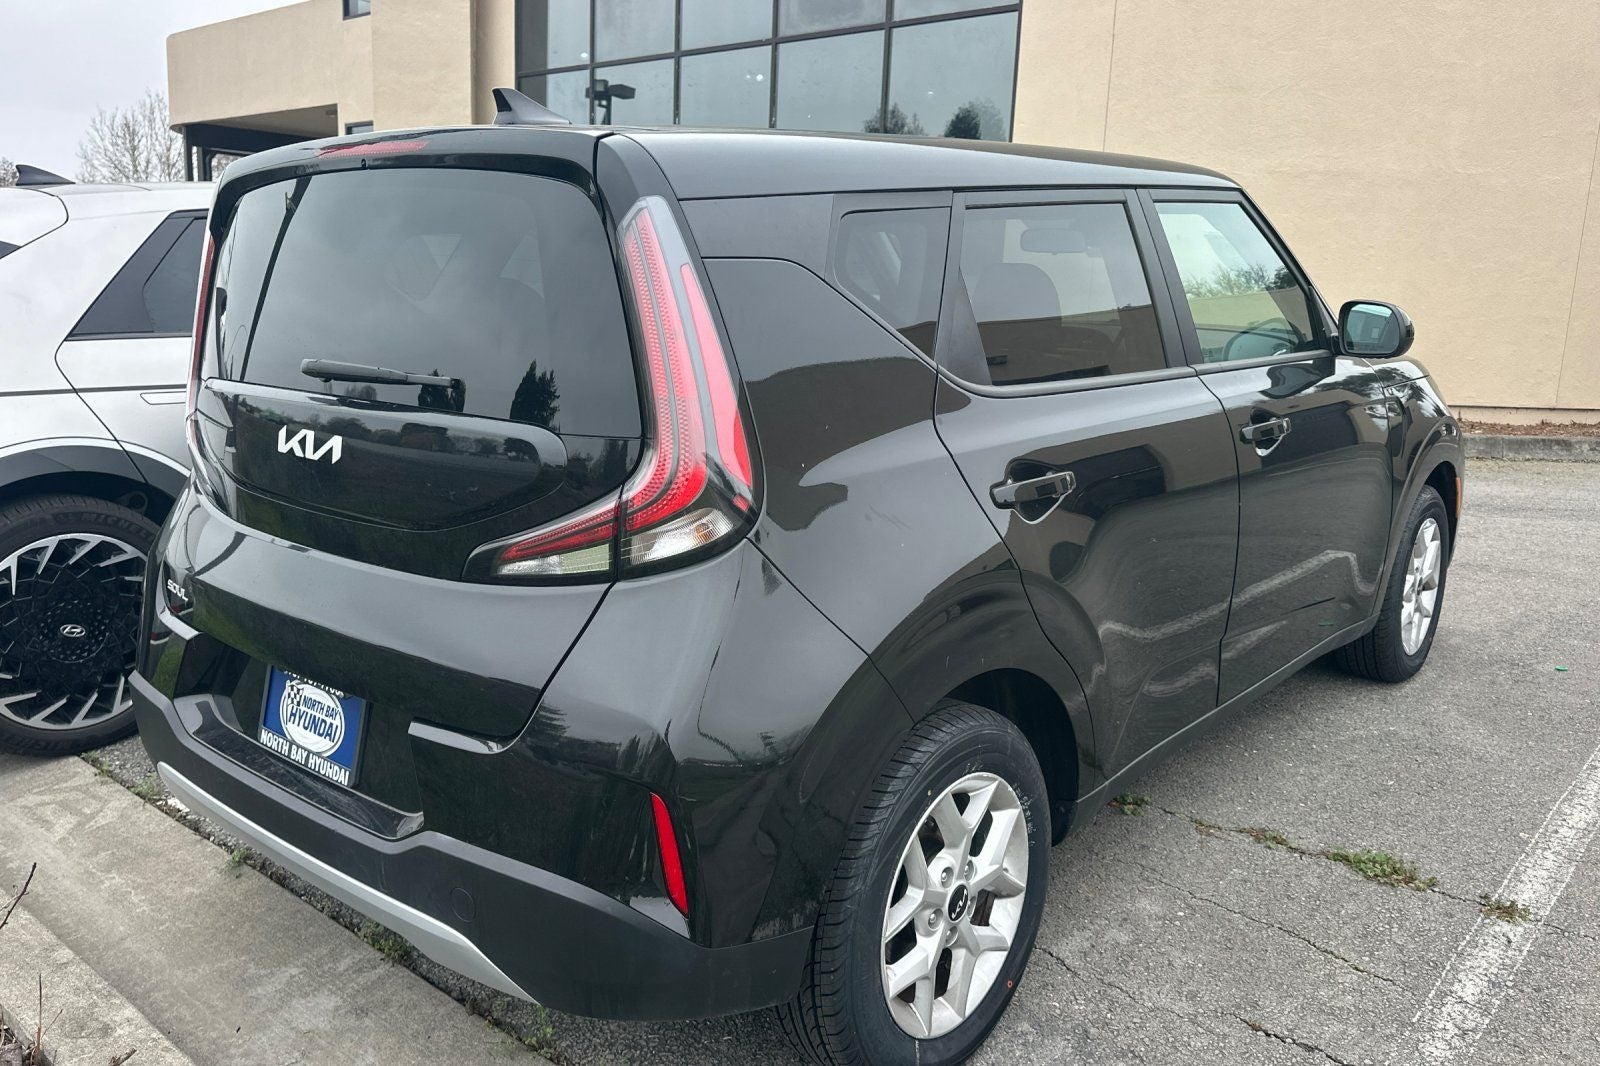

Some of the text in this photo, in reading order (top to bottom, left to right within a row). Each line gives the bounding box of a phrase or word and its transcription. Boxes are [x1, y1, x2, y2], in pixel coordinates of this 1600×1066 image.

[278, 425, 342, 464] KIA
[167, 579, 189, 601] SOUL
[288, 705, 339, 743] HYUNDAI
[301, 695, 340, 721] NORTH BAY
[260, 729, 350, 786] NORTH BAY HYUNDAI
